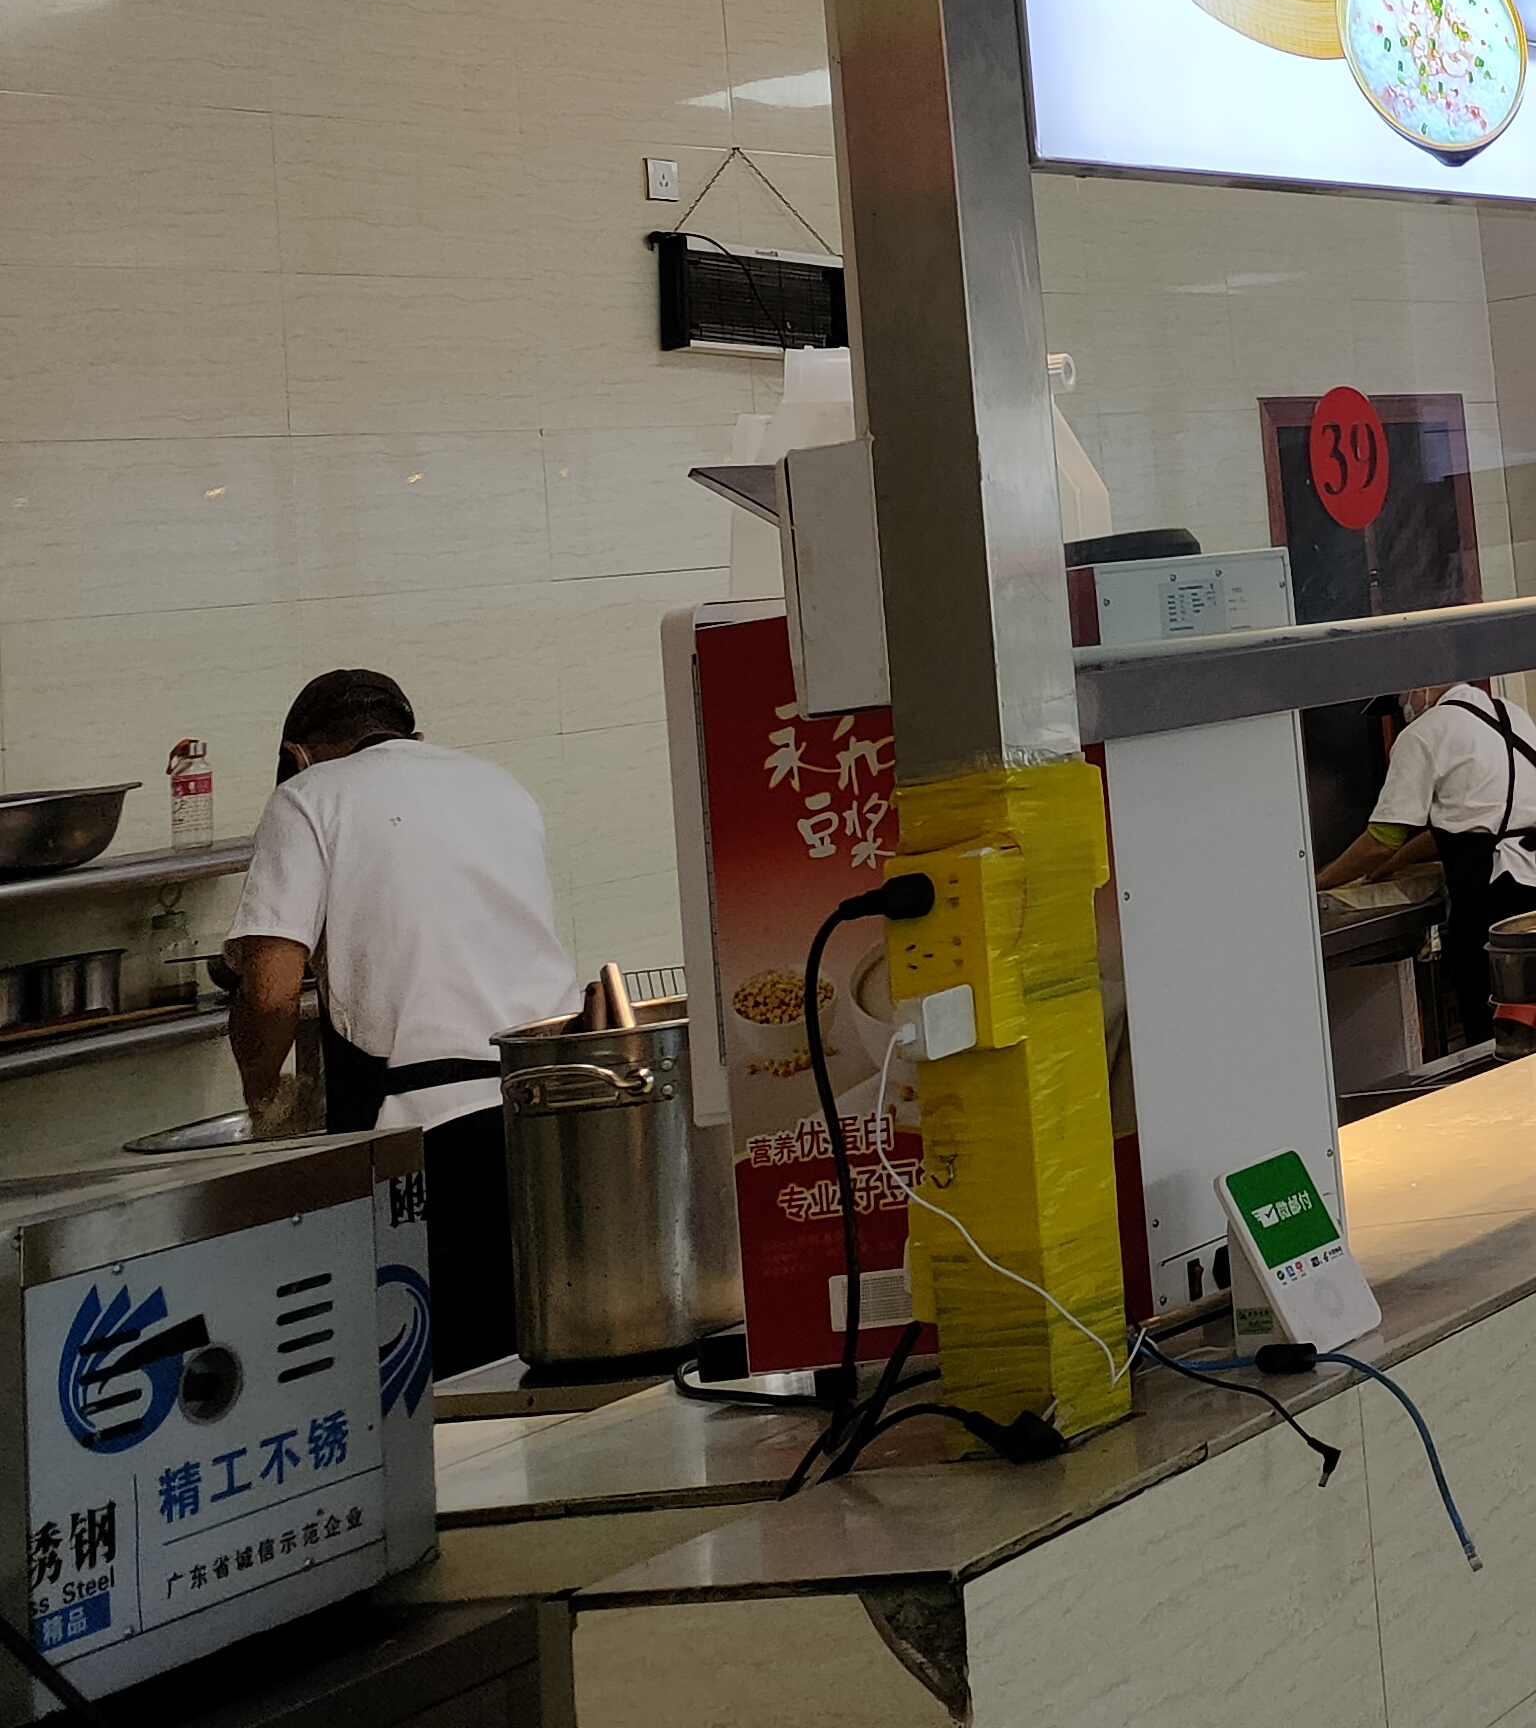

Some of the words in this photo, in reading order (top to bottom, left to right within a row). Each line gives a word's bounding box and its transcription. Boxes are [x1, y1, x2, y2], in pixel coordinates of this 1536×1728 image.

[1320, 421, 1378, 496] 39
[764, 701, 896, 797] 永和
[797, 792, 896, 870] 豆浆
[777, 1159, 925, 1222] 专业好豆
[158, 1410, 350, 1524] 精工不锈
[62, 1565, 115, 1604] Steel
[166, 1505, 364, 1600] 广东省诚信示范企业
